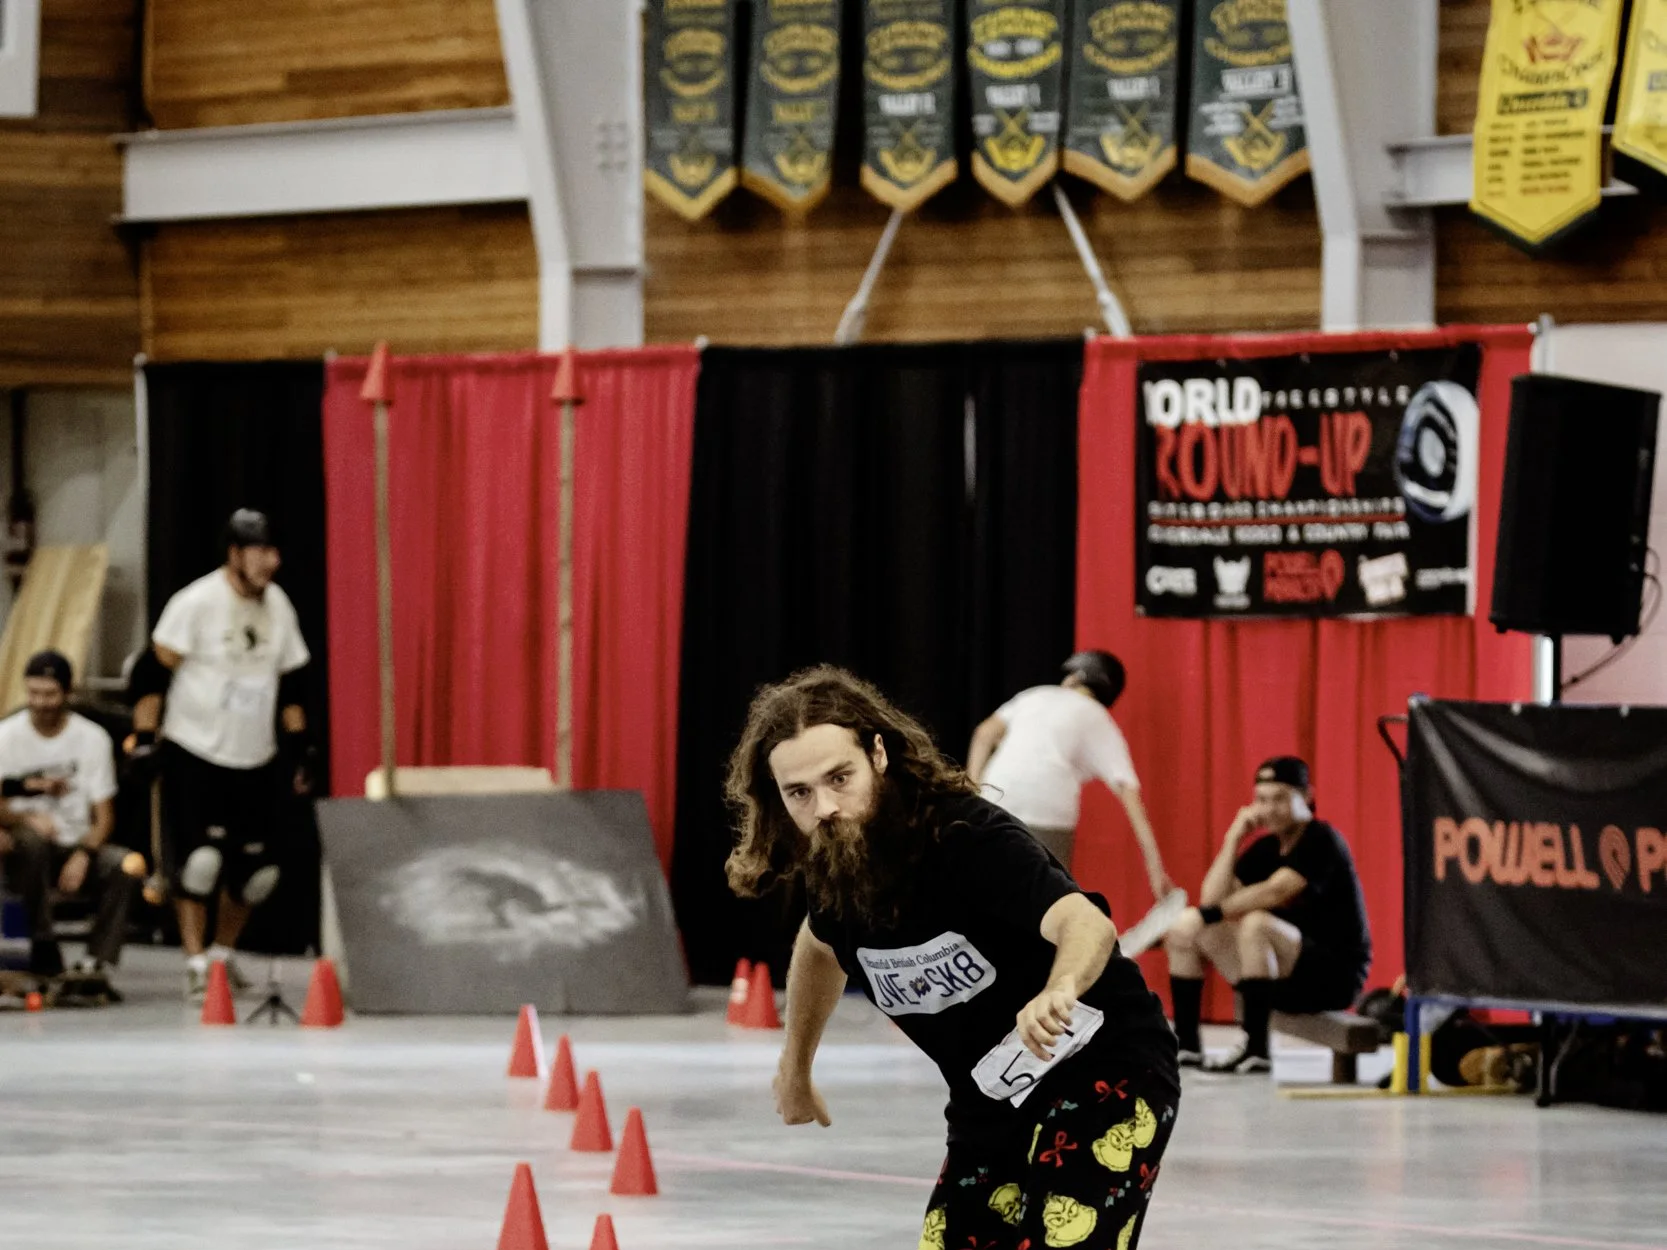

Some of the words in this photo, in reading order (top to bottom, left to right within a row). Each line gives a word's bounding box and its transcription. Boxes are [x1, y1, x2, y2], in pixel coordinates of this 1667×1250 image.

[1432, 817, 1600, 890] POWELL
[915, 942, 960, 966] Columbia
[923, 950, 986, 998] SK8
